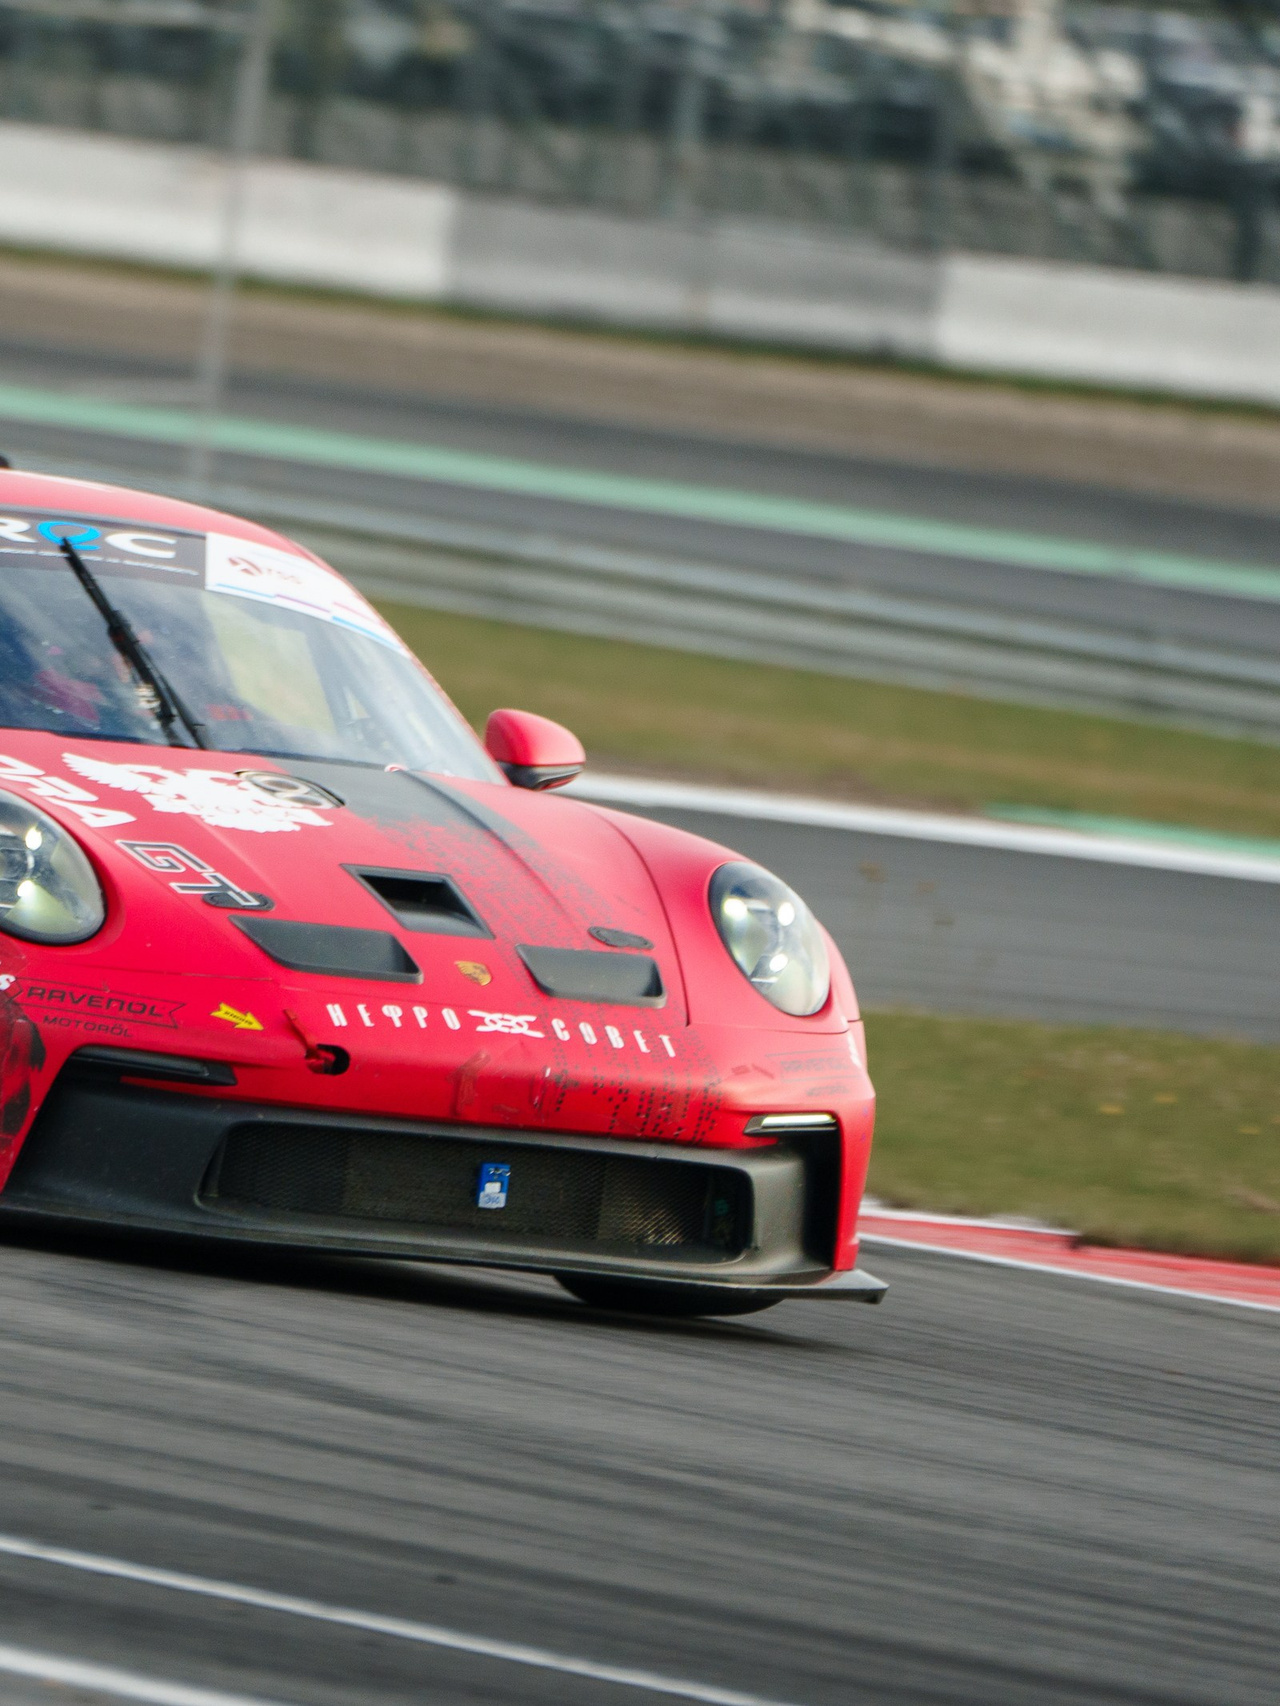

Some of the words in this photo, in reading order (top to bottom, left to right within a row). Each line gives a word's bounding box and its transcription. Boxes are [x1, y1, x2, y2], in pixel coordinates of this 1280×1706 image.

[116, 839, 262, 907] GT
[27, 985, 164, 1018] RAVENOL
[42, 1014, 134, 1038] MOTORÖL
[326, 1003, 461, 1031] НЕФРО
[551, 1018, 676, 1057] СОВЕТ
